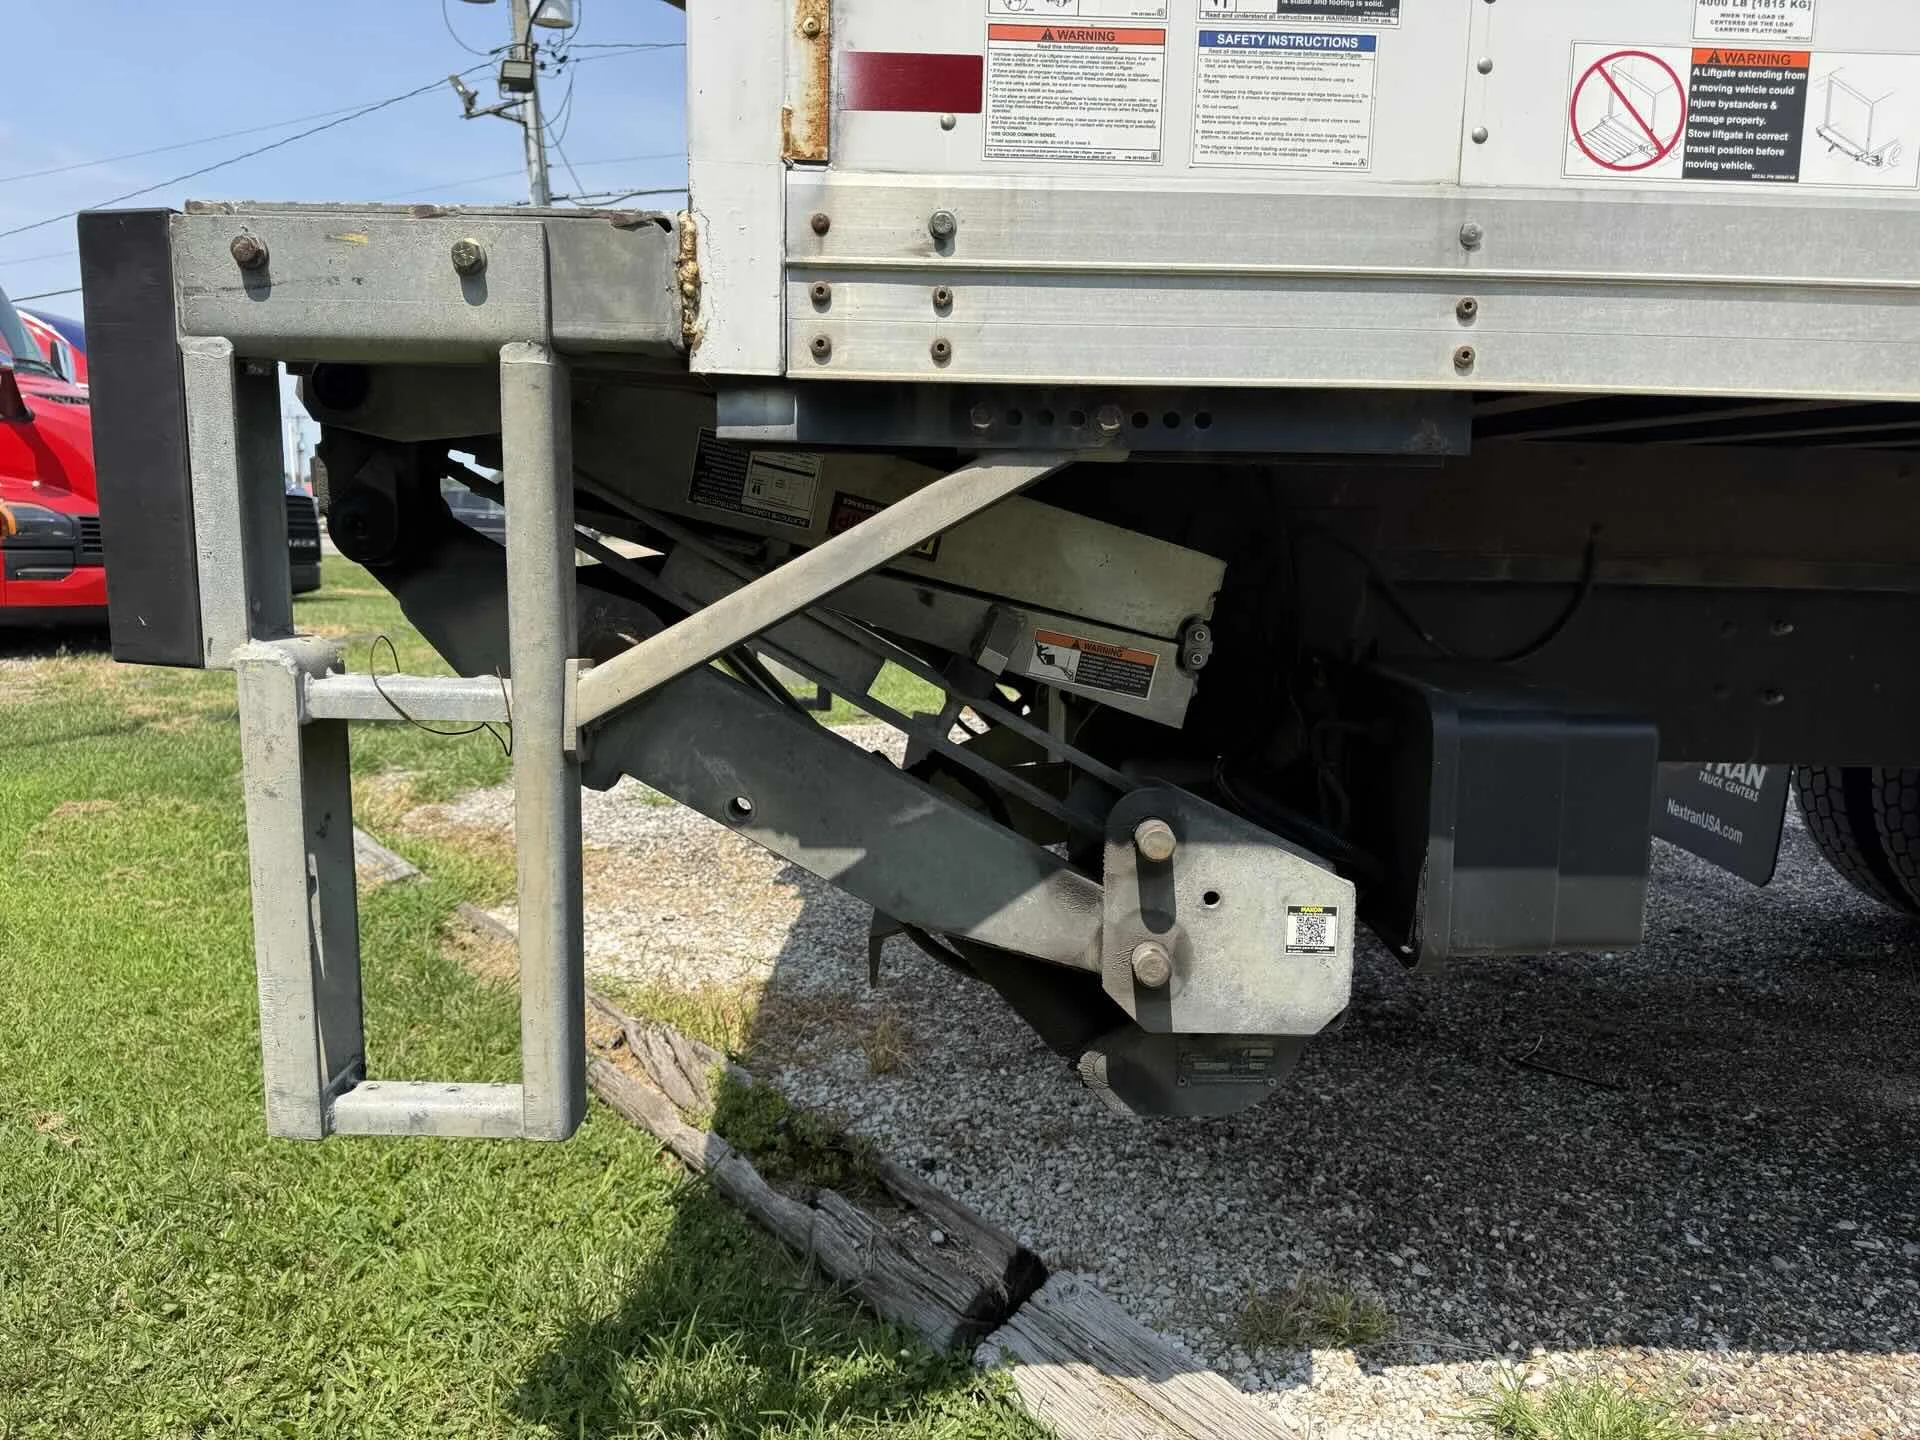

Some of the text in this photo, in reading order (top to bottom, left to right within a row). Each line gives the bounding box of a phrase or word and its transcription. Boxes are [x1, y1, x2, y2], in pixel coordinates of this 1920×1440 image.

[1790, 0, 1811, 10] KG]
[1057, 29, 1115, 42] WARNING
[1216, 33, 1359, 49] SAFETY INSTRUCTIONS
[1724, 52, 1791, 65] WARNING
[1692, 68, 1806, 81] A Liftgate extending from
[1699, 84, 1733, 94] moving
[1735, 84, 1767, 94] vehicle
[1769, 85, 1795, 95] could
[1690, 99, 1778, 111] injure bystanders &
[1689, 114, 1767, 127] damage property.
[1687, 129, 1789, 141] Stow liftgate in correct
[1686, 144, 1785, 156] transit position before
[1685, 160, 1755, 171] moving vehicle.
[1083, 640, 1124, 657] WARNING
[1698, 770, 1759, 802] TRUCK CENTERS
[1667, 797, 1743, 846] NextranUSA.com
